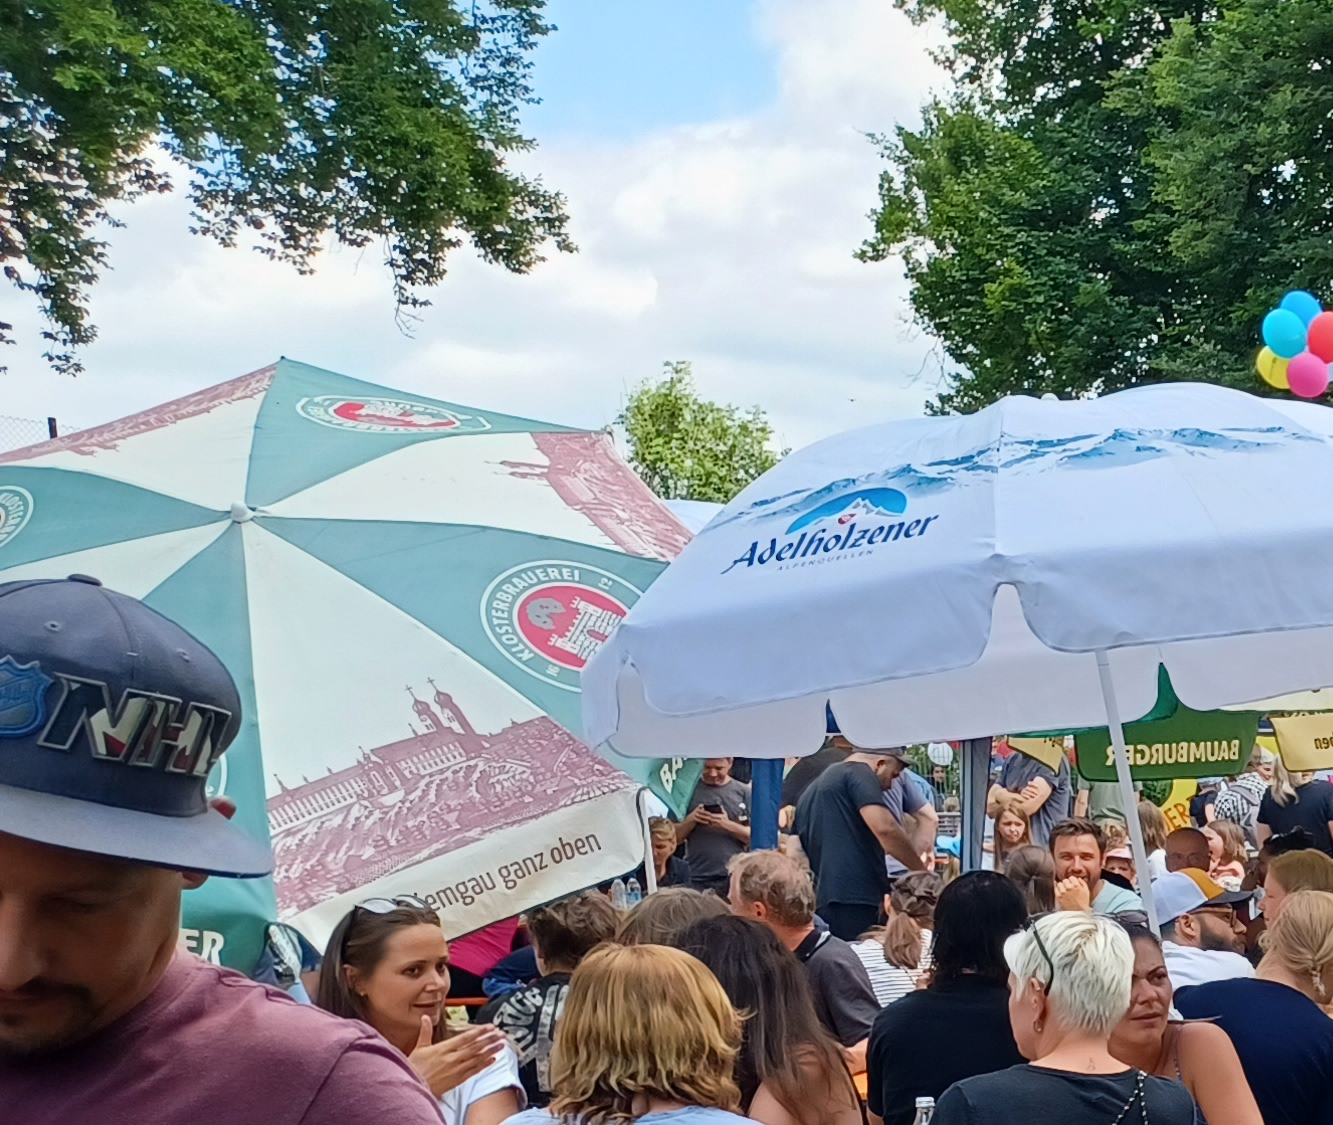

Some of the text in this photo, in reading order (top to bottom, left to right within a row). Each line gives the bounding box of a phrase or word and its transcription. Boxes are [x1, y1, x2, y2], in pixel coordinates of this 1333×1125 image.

[720, 515, 940, 575] Adelholzener
[492, 567, 580, 662] KLOSTERBRAUEREI
[498, 851, 549, 890] ganz
[550, 833, 602, 864] oben
